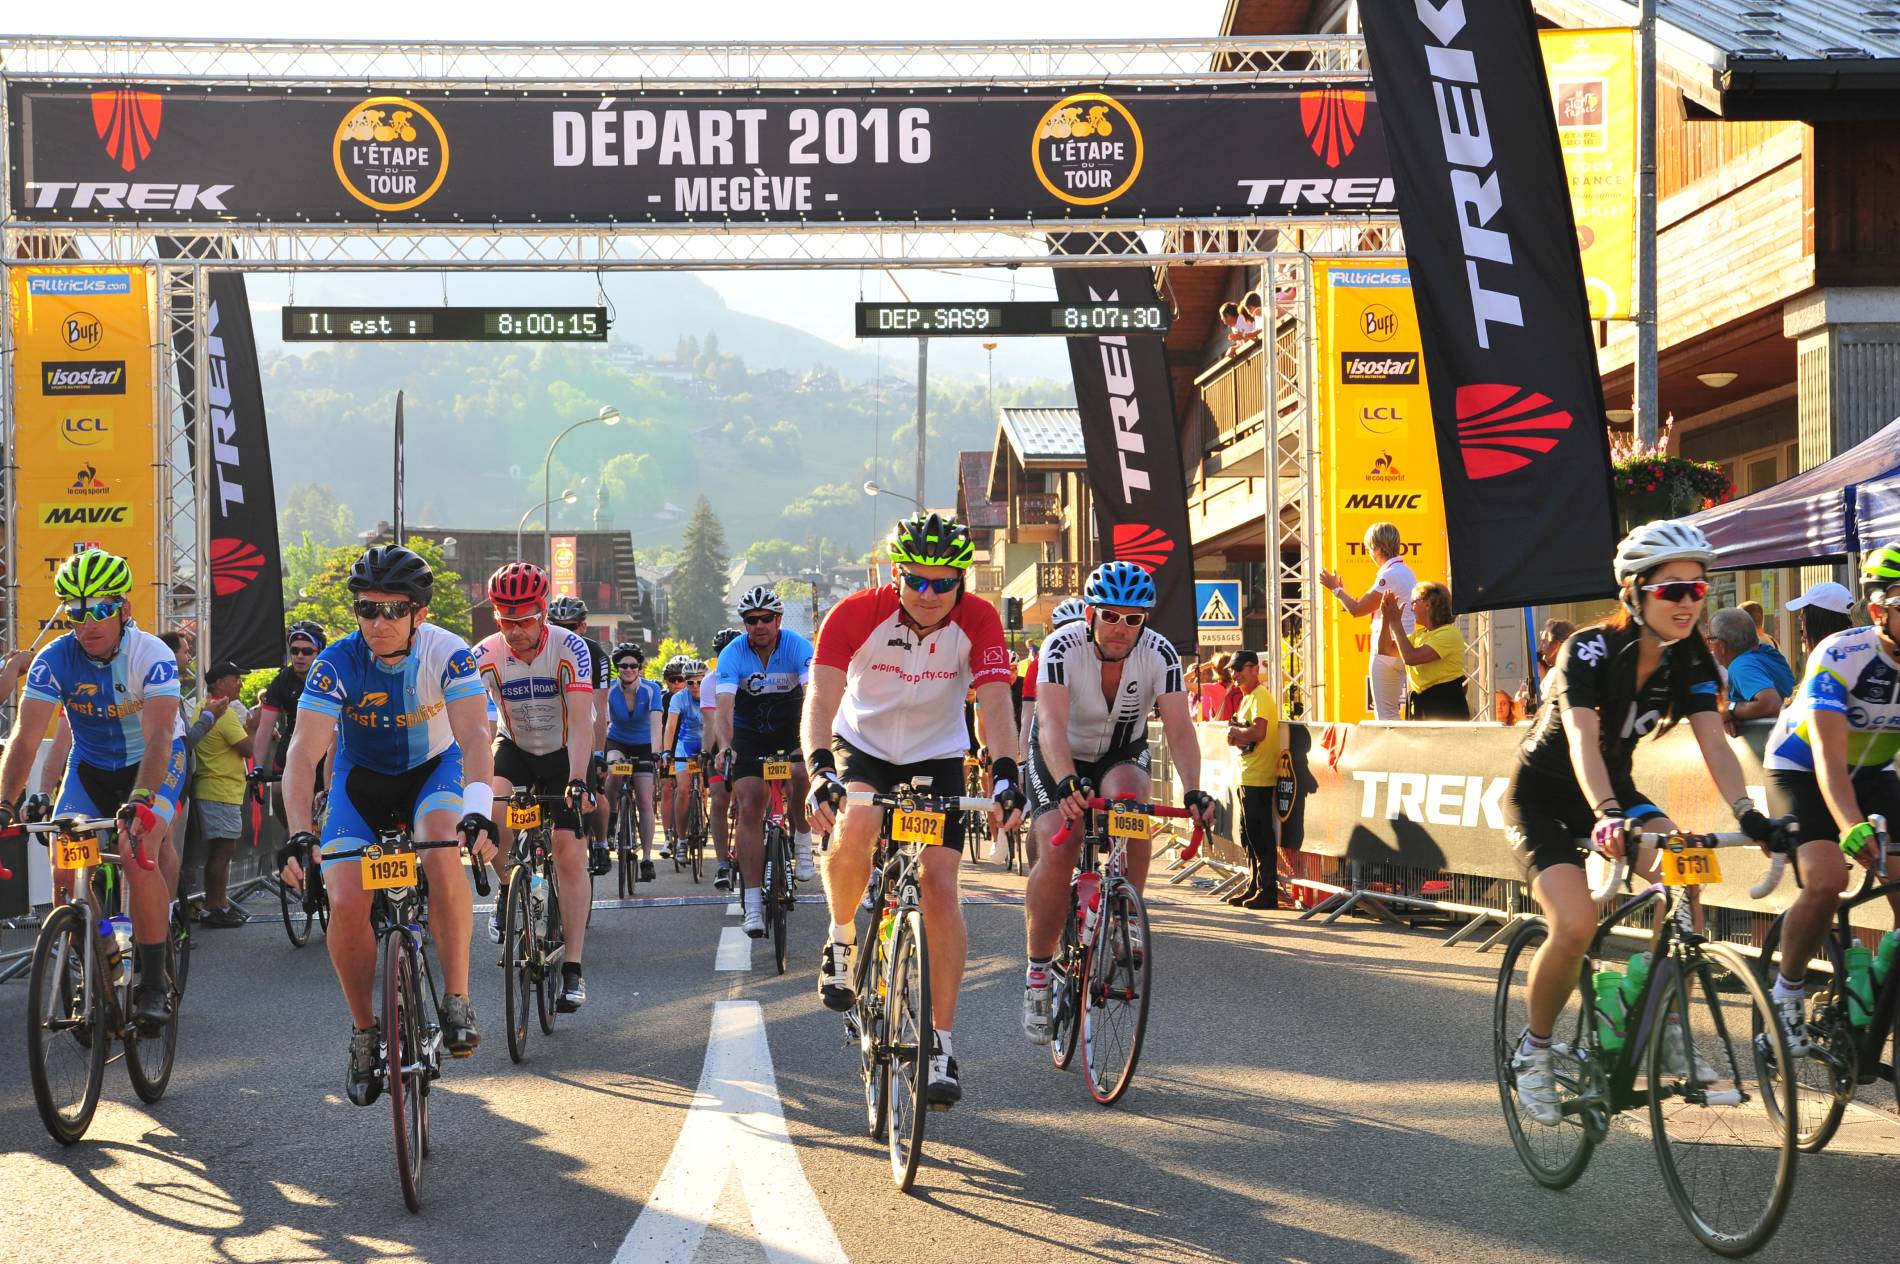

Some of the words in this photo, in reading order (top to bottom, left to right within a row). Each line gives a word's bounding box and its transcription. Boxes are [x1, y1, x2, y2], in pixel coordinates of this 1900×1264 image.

[553, 97, 767, 166] DÉPART
[788, 107, 931, 164] 2016
[353, 142, 429, 166] L'ÉTAPE
[1051, 138, 1124, 161] L'ÉTAPE
[367, 175, 416, 194] TOUR
[1064, 170, 1111, 189] TOUR
[25, 183, 235, 210] TREK
[675, 168, 812, 211] MEGÈVE
[32, 279, 127, 291] Alltricks.com
[350, 315, 392, 334] est
[498, 313, 597, 334] 8:00:15
[879, 309, 990, 329] DEP.SAS9
[1064, 307, 1161, 329] 8:07:30
[1363, 407, 1403, 420] LCL
[65, 418, 108, 431] LCL
[1385, 474, 1405, 482] sportif
[88, 487, 110, 495] sportif
[1345, 494, 1422, 509] MAVIC
[44, 506, 128, 523] MAVIC
[562, 633, 591, 678] ROADS
[502, 684, 529, 697] ESSEX
[1352, 770, 1511, 830] TREK
[511, 811, 536, 824] 12935
[901, 815, 937, 836] 14302
[1114, 815, 1144, 832] 10589
[370, 860, 408, 880] 11925
